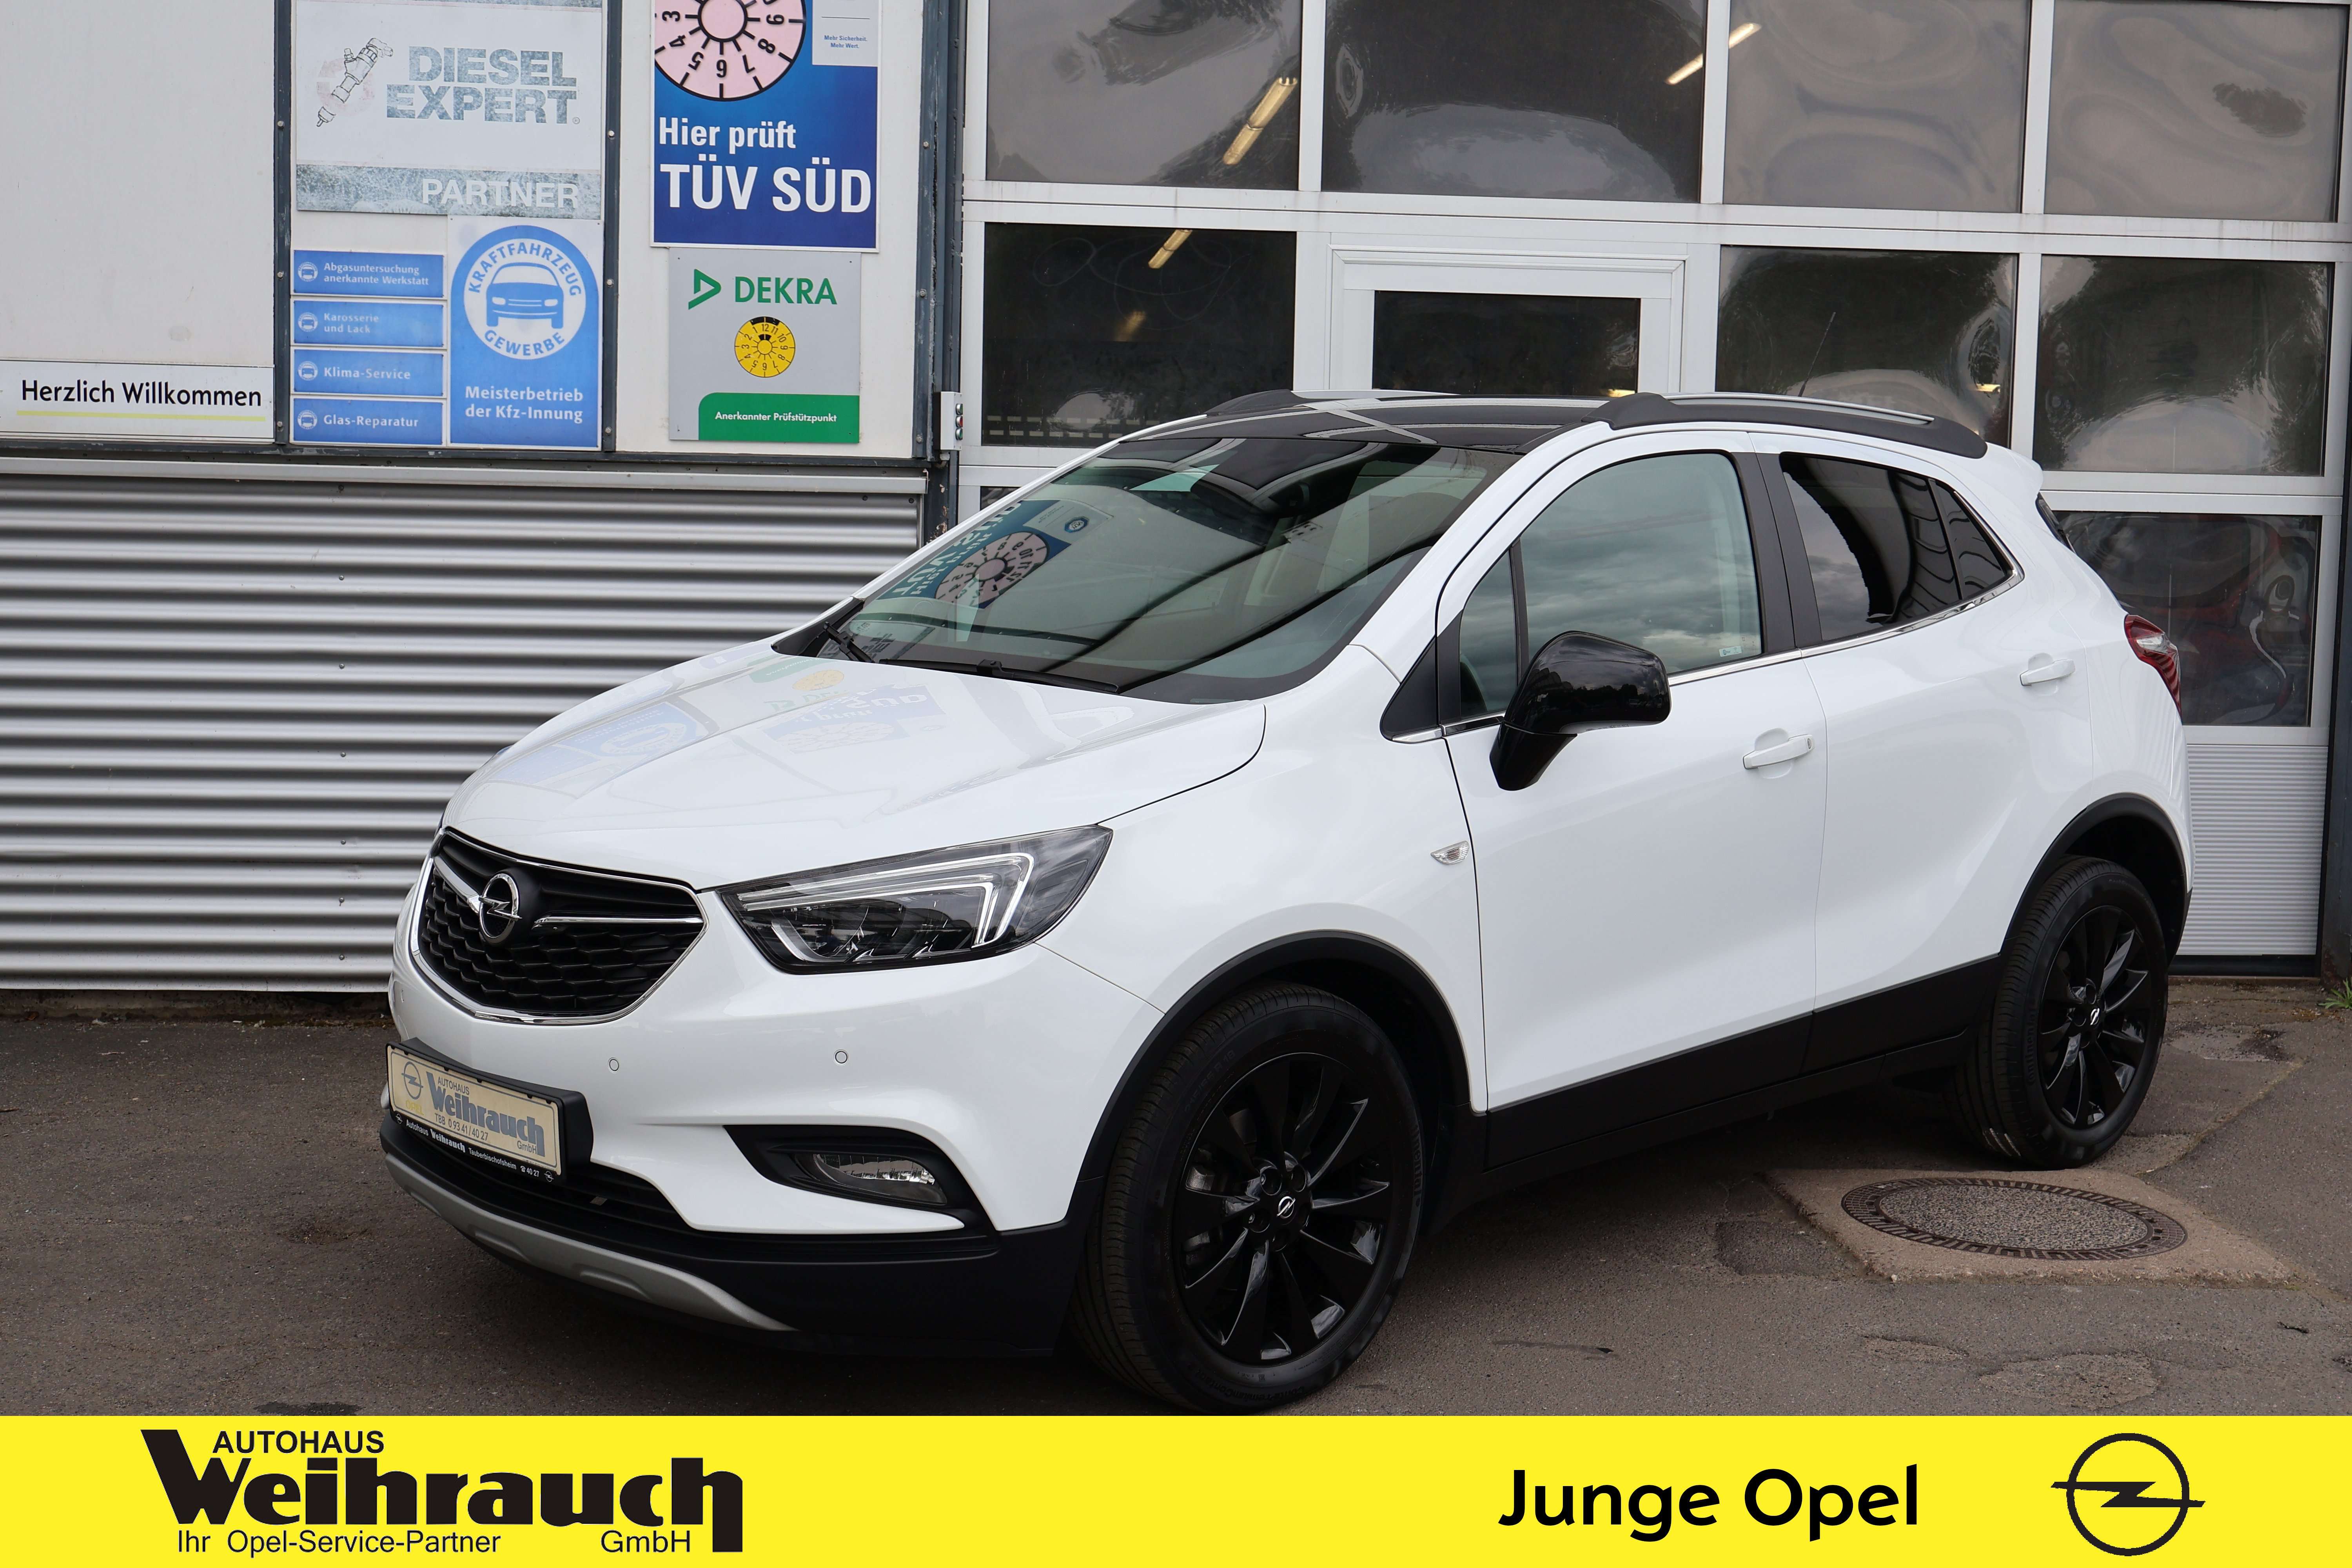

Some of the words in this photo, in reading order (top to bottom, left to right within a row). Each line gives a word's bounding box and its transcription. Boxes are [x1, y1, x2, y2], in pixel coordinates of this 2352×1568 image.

[662, 11, 681, 22] 3
[669, 34, 686, 47] 4
[758, 38, 775, 53] 8
[409, 46, 577, 87] DIESEL
[688, 52, 704, 70] 5
[742, 54, 755, 73] 7
[659, 117, 720, 146] Hier
[729, 121, 796, 154] prüft
[660, 154, 758, 210] TÜV
[772, 157, 871, 212] SÜD
[423, 178, 579, 208] PARTNER
[323, 262, 419, 276] Abgasuntersuchung
[468, 241, 582, 297] KRAFTFAHRZEUG
[323, 274, 380, 285] anerkannte
[382, 276, 428, 285] Werkstatt
[735, 276, 838, 305] DEKRA
[324, 313, 379, 323] Karosserie
[324, 324, 344, 333] und
[347, 324, 370, 334] Lack
[771, 326, 779, 334] 11
[484, 329, 565, 356] GEWERBE
[777, 333, 787, 343] 10
[324, 368, 411, 380] Klima-Service
[22, 379, 115, 403] Herzlich
[122, 381, 261, 407] Willkommen
[465, 385, 584, 402] Meisterbetrieb
[323, 414, 419, 428] Glas-Reparatur
[465, 404, 491, 417] der
[496, 406, 583, 424] Kfz-Innung
[715, 411, 771, 422] Anerkannter
[773, 412, 837, 424] Prüfstützpunkt
[437, 1076, 470, 1096] AUTOHAUS
[426, 1071, 545, 1157] Weihrauch
[435, 1112, 446, 1125] TBB
[406, 1119, 429, 1136] Autohaus
[430, 1129, 466, 1153] Weihrauch
[468, 1147, 517, 1170] Tauberbischofsheim
[517, 1140, 537, 1155] GmbH
